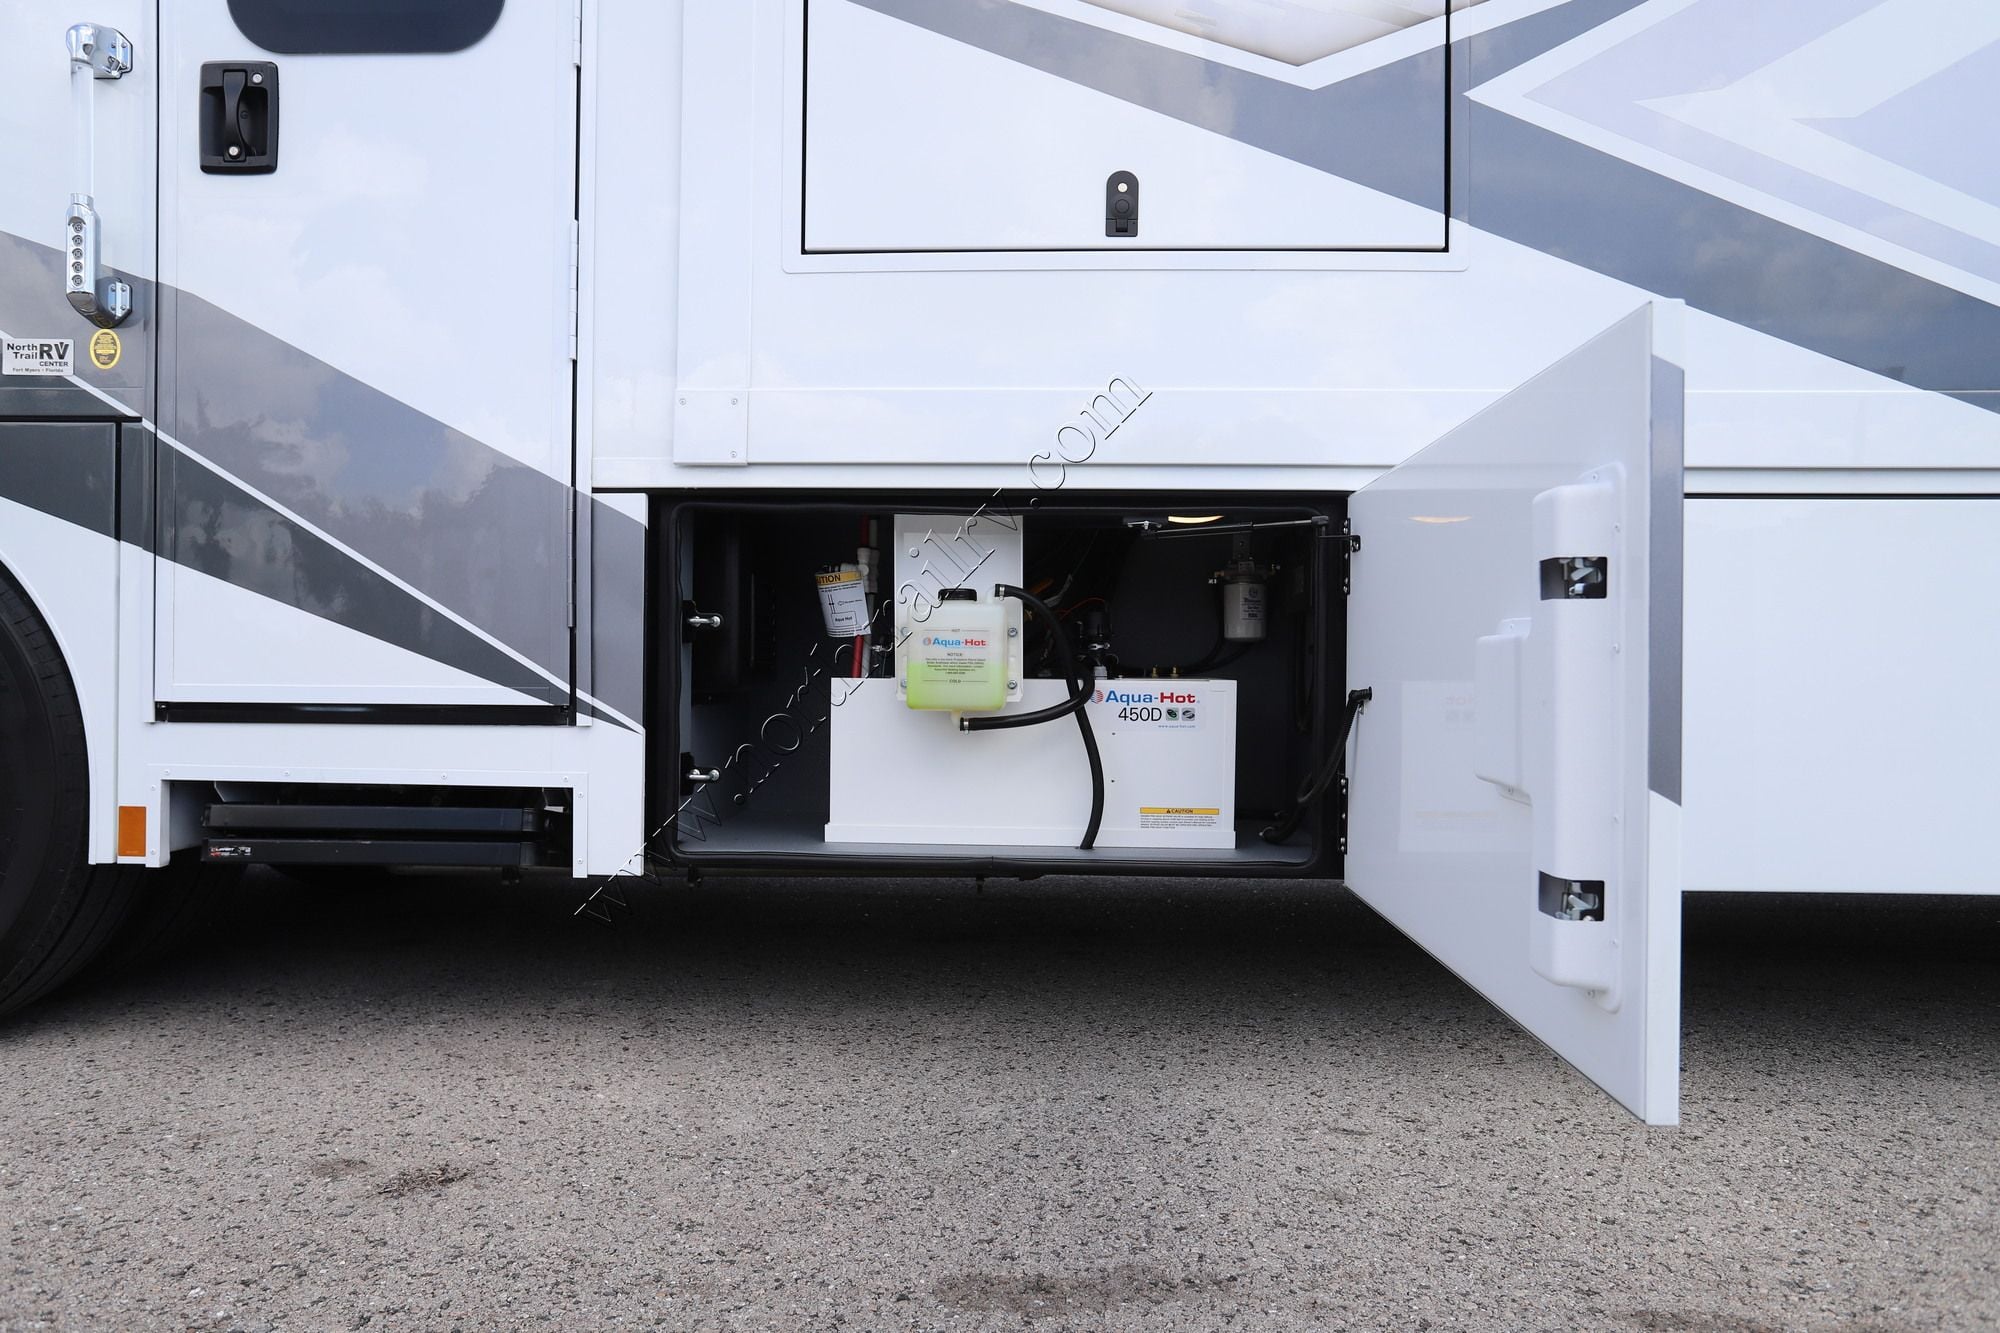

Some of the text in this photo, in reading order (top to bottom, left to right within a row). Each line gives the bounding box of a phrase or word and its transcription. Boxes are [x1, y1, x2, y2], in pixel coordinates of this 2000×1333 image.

[7, 343, 37, 351] North
[39, 342, 70, 360] RV
[13, 351, 38, 360] Trail
[932, 637, 987, 648] Aqua-Hot
[1105, 690, 1196, 706] Aqua-Hot
[1118, 707, 1163, 721] 450D
